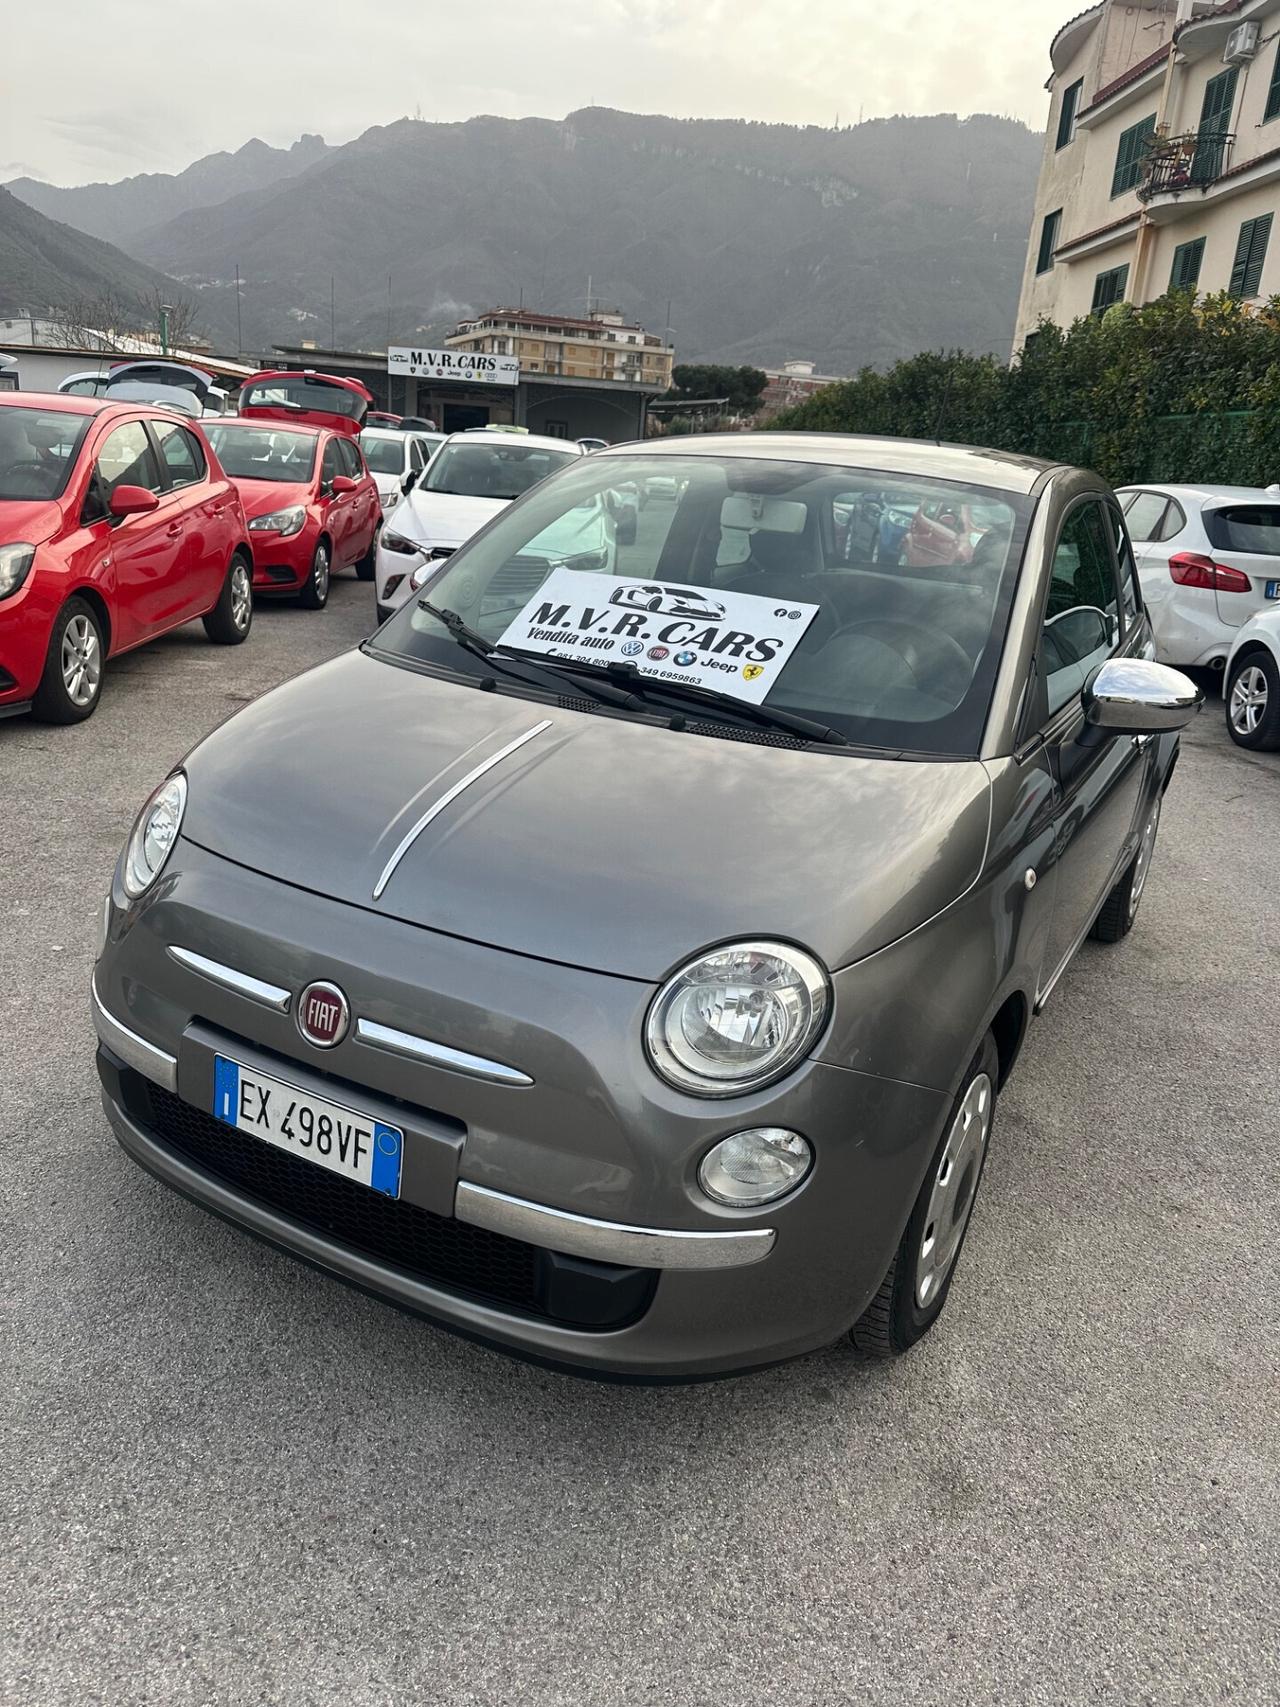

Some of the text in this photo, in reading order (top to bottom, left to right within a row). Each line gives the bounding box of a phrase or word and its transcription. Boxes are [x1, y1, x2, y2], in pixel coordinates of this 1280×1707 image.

[527, 627, 616, 650] Vendita auto
[575, 655, 591, 663] 304
[700, 658, 738, 673] Jeep
[659, 670, 702, 685] 6959863
[308, 998, 338, 1032] FIAT
[240, 1079, 372, 1168] EX 498VF
